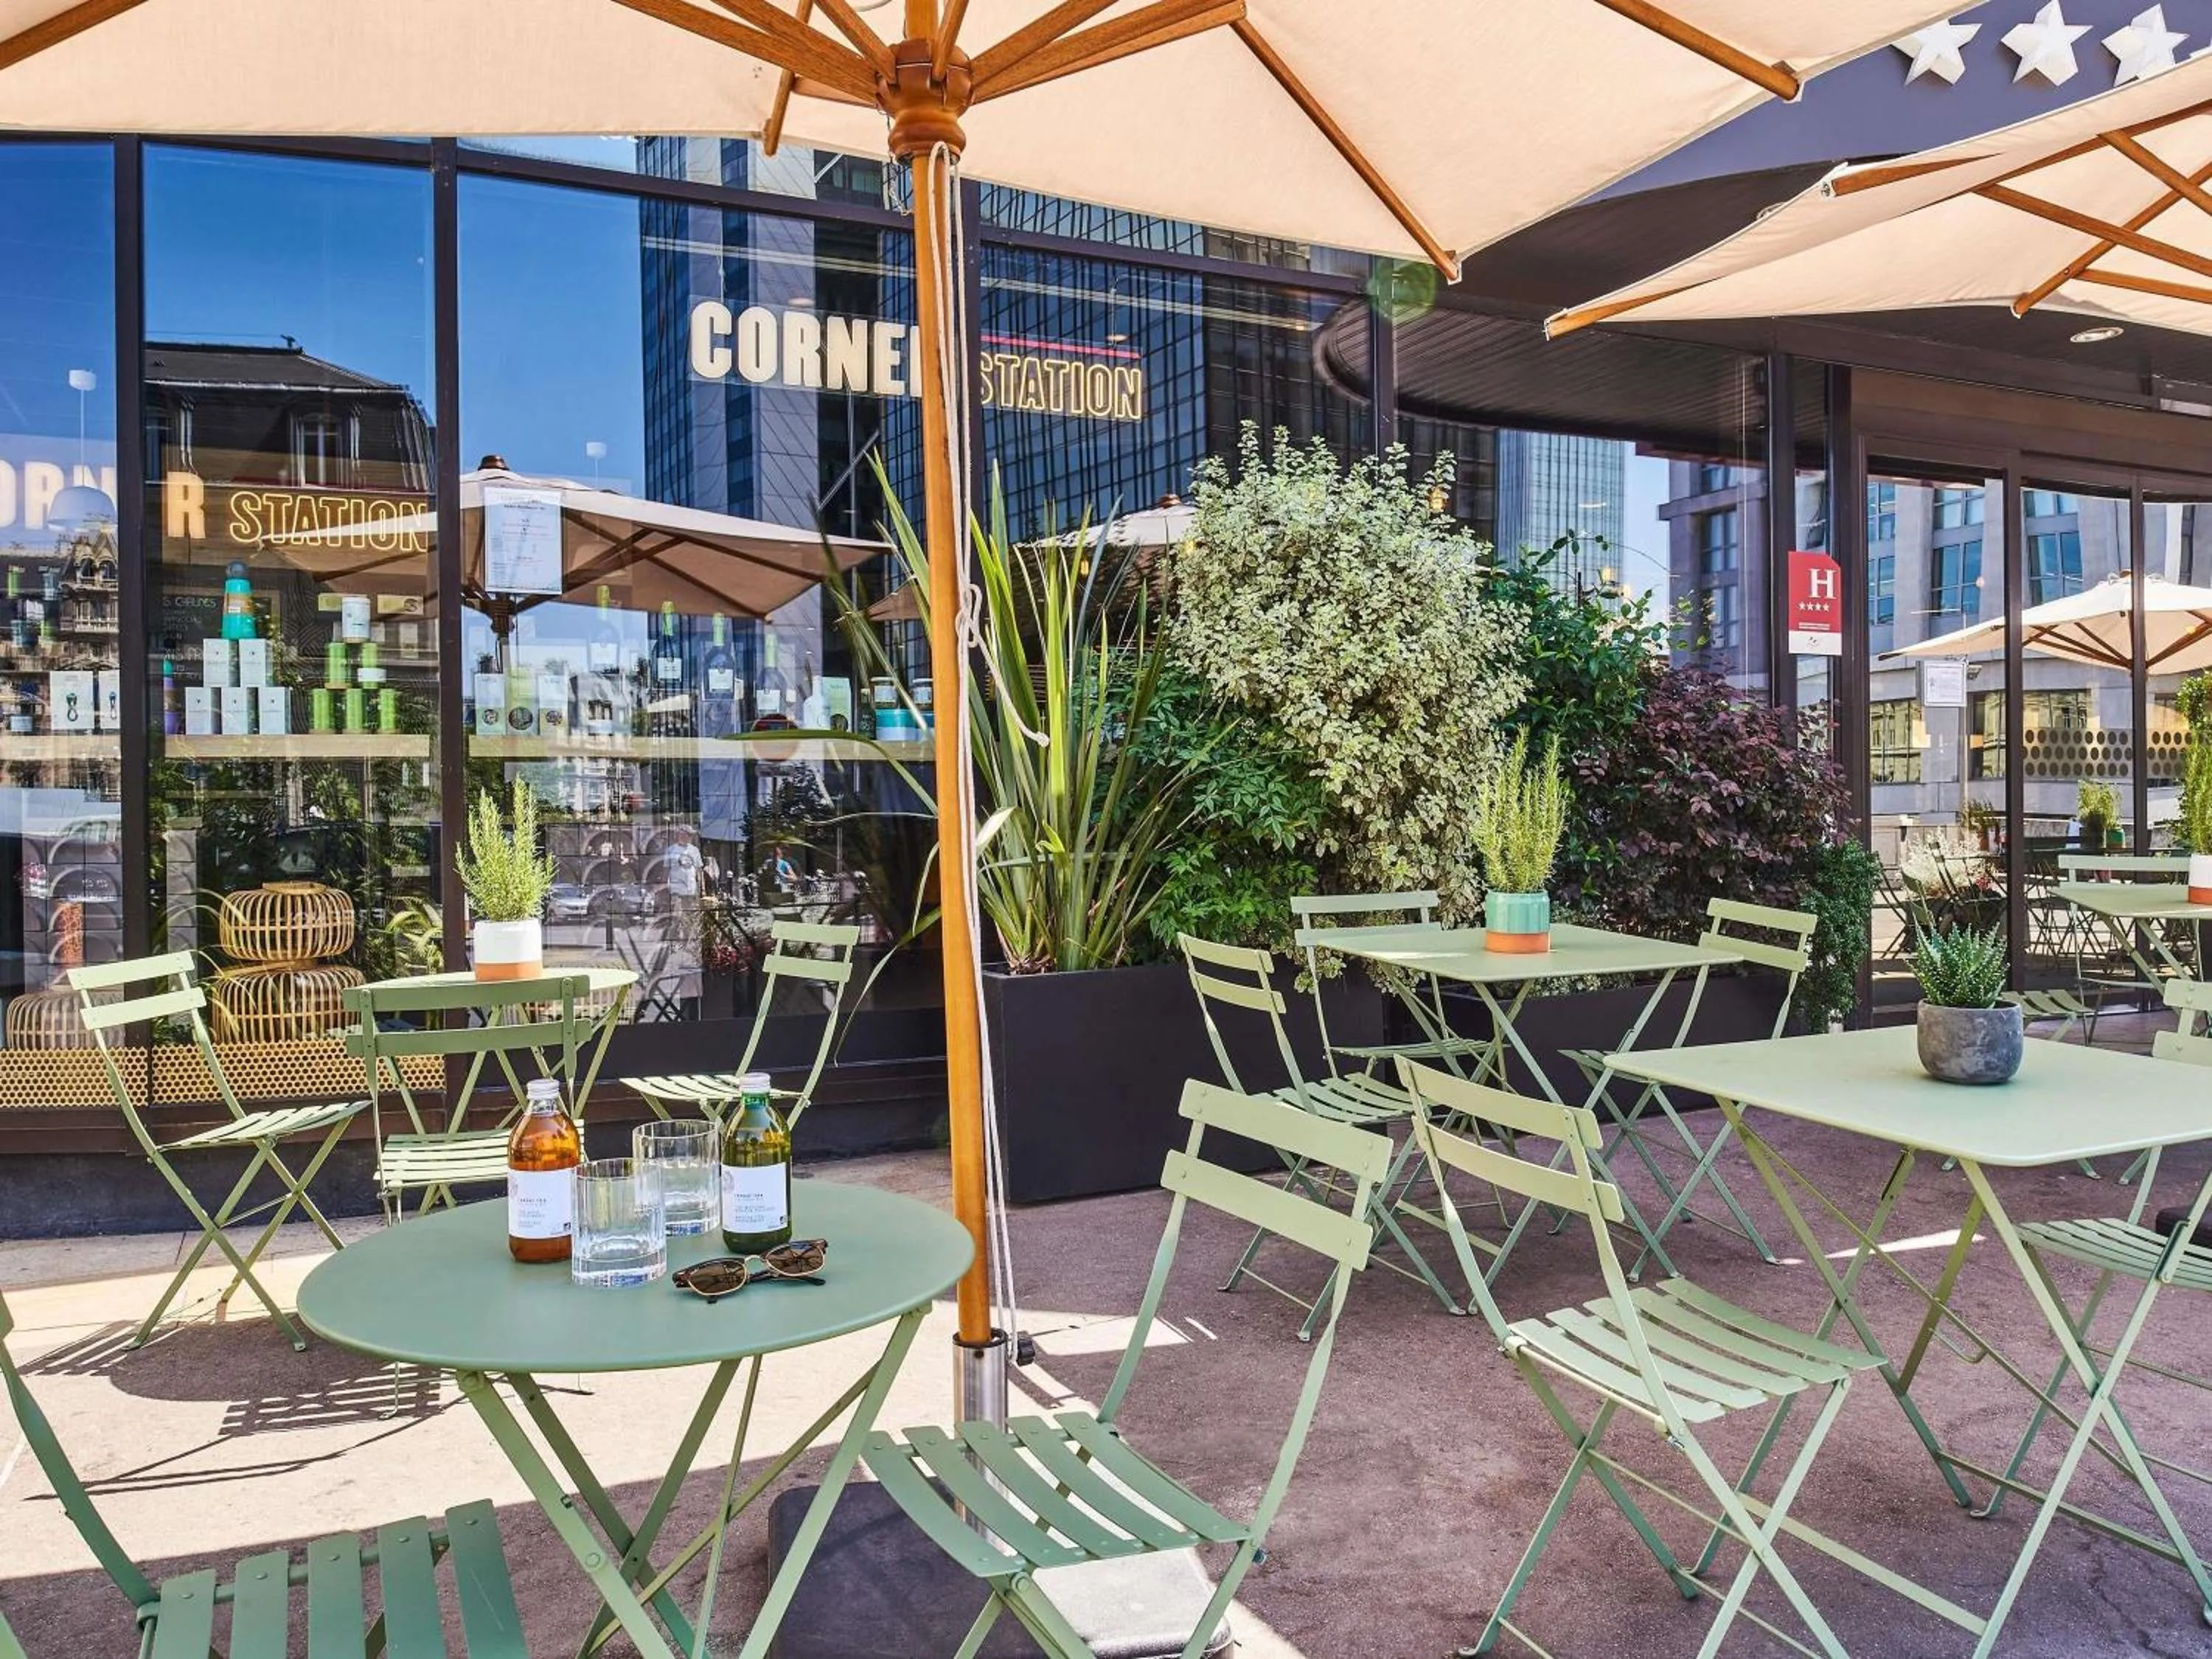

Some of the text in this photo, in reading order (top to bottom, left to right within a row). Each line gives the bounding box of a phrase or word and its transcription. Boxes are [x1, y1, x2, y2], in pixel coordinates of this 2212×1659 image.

[692, 302, 922, 397] CORNE
[230, 490, 429, 552] STATION
[1808, 568, 1837, 599] H
